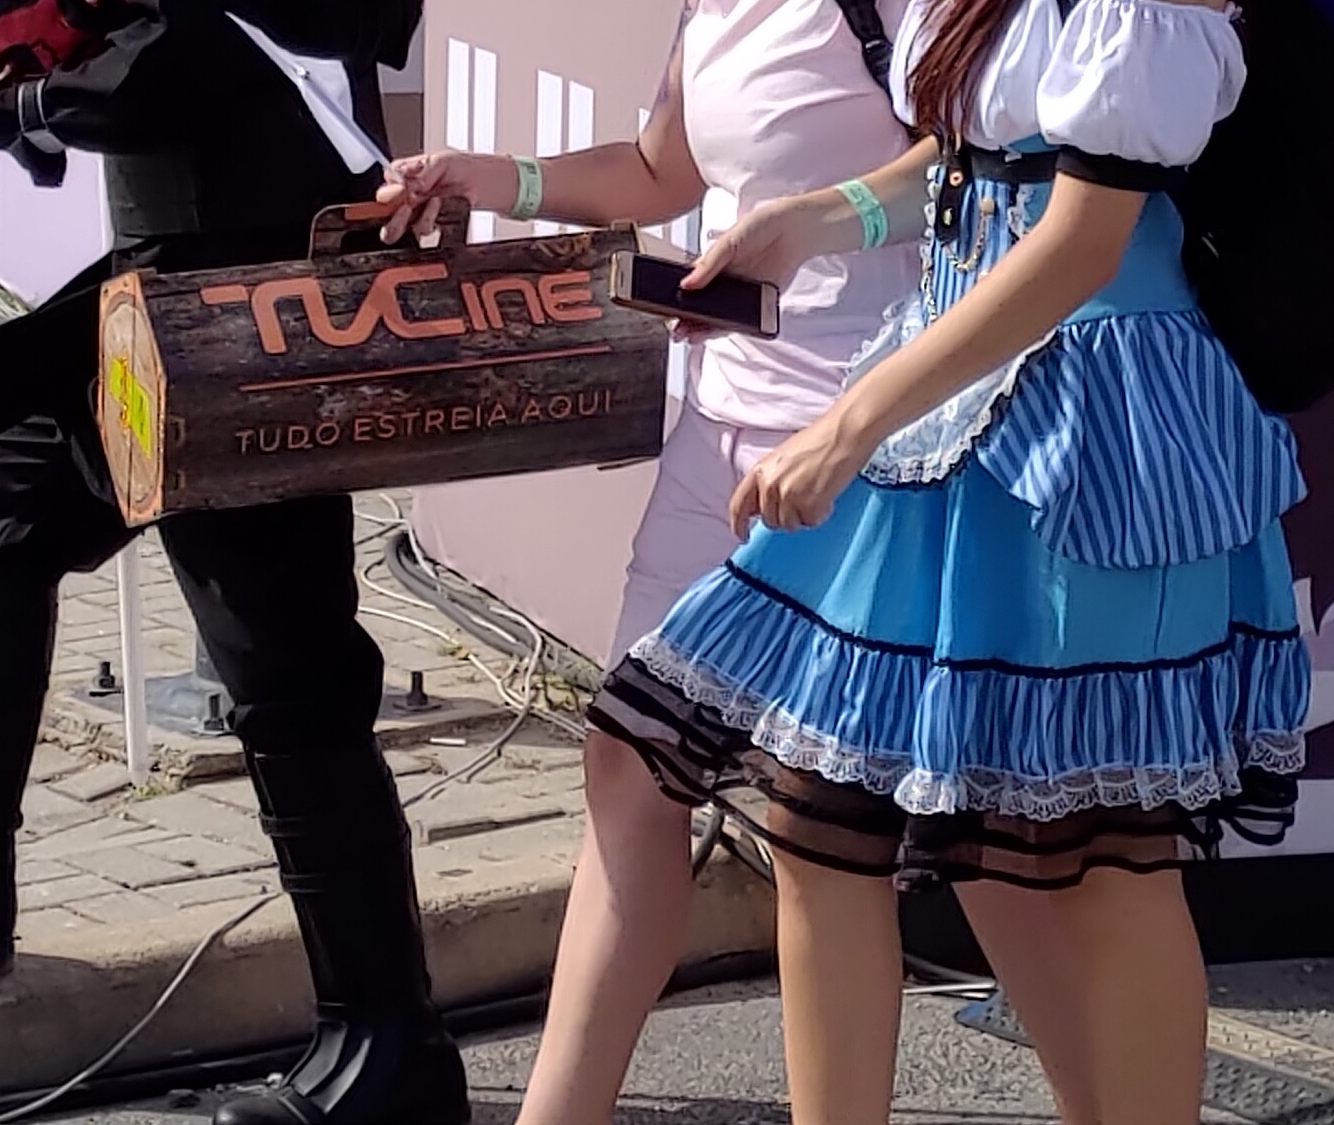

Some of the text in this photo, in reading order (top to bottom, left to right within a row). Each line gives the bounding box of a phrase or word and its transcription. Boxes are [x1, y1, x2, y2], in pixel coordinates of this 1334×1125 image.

[235, 389, 612, 455] TUDO ESTREIA AQUI
